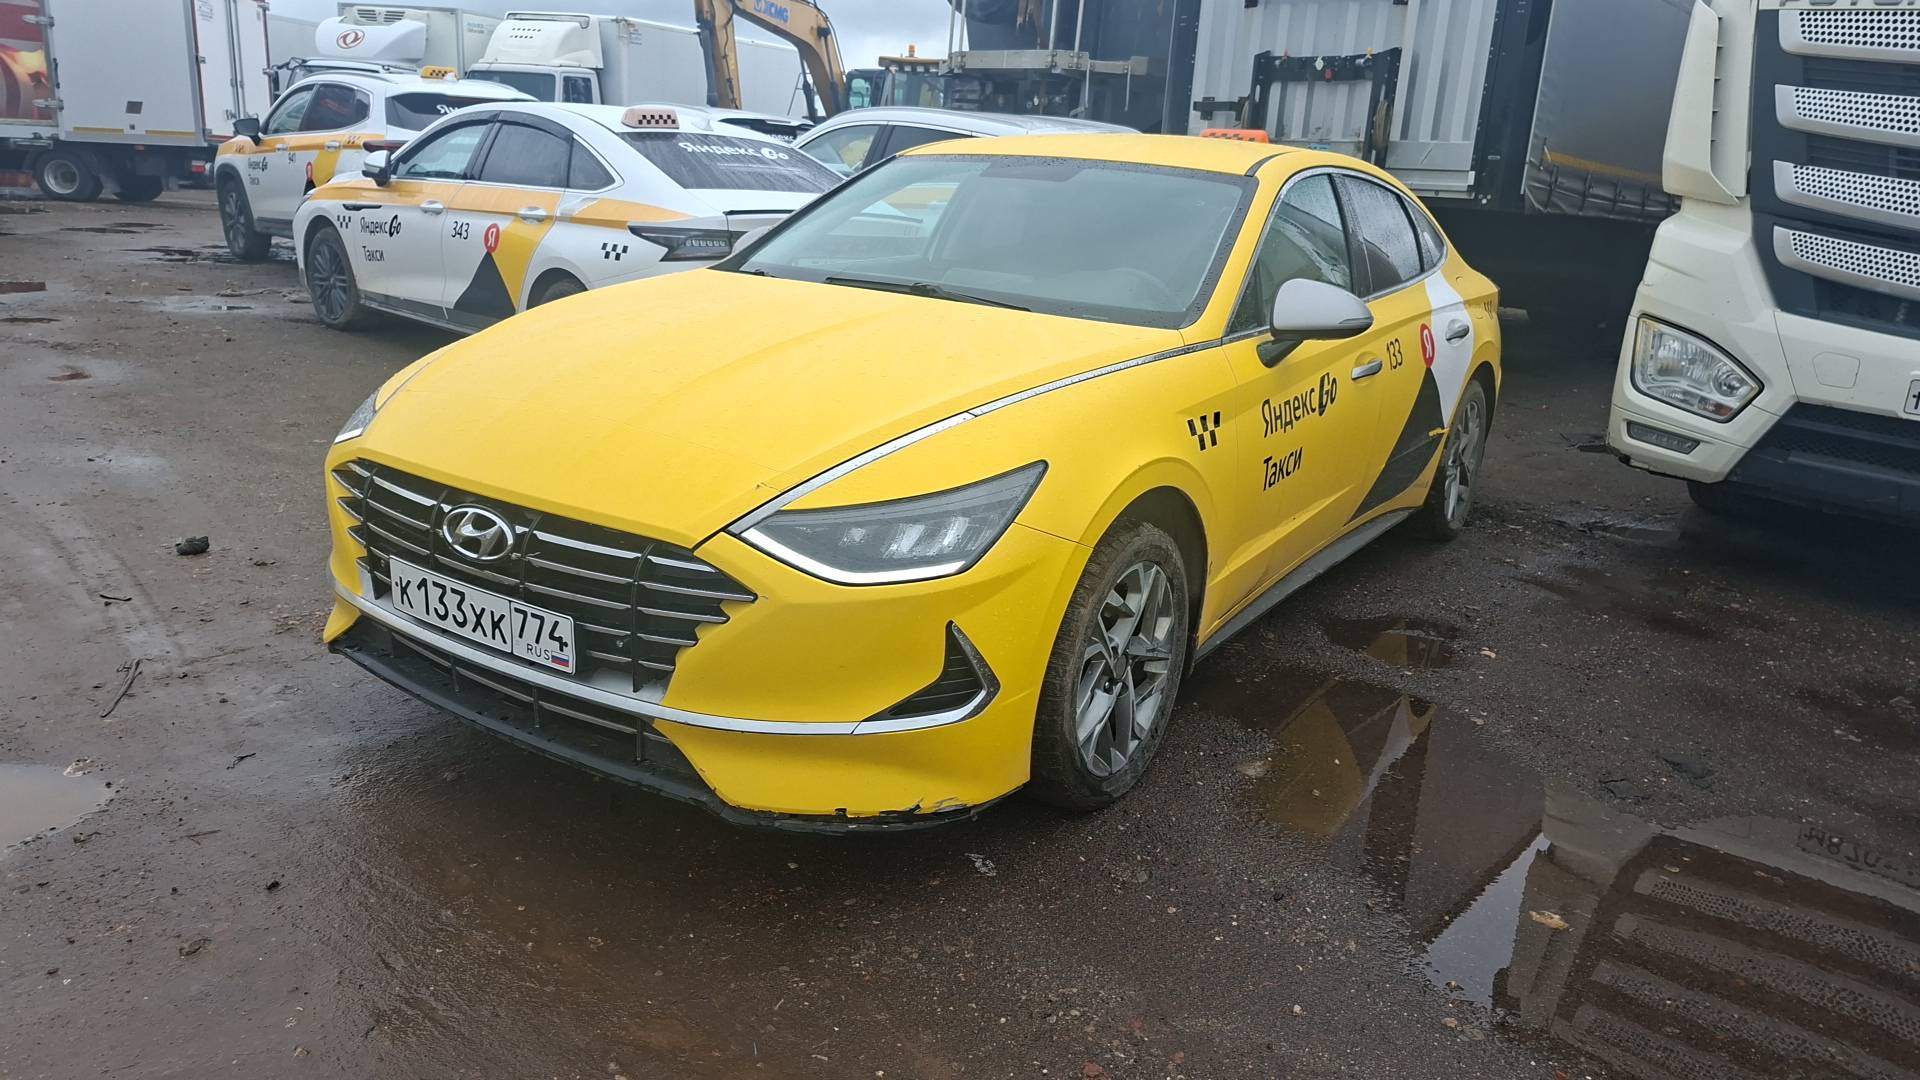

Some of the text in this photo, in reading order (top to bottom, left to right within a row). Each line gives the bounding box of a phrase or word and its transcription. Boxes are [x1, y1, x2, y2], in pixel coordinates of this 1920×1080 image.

[678, 142, 789, 160] Яндекс Go
[360, 214, 401, 237] Яндекс Go
[451, 221, 469, 240] 343
[362, 246, 385, 262] Такси
[1386, 338, 1403, 371] 133
[1262, 372, 1337, 438] Яндекс Go
[1263, 447, 1303, 491] Такси
[514, 607, 568, 652] 774
[527, 643, 550, 661] RUS
